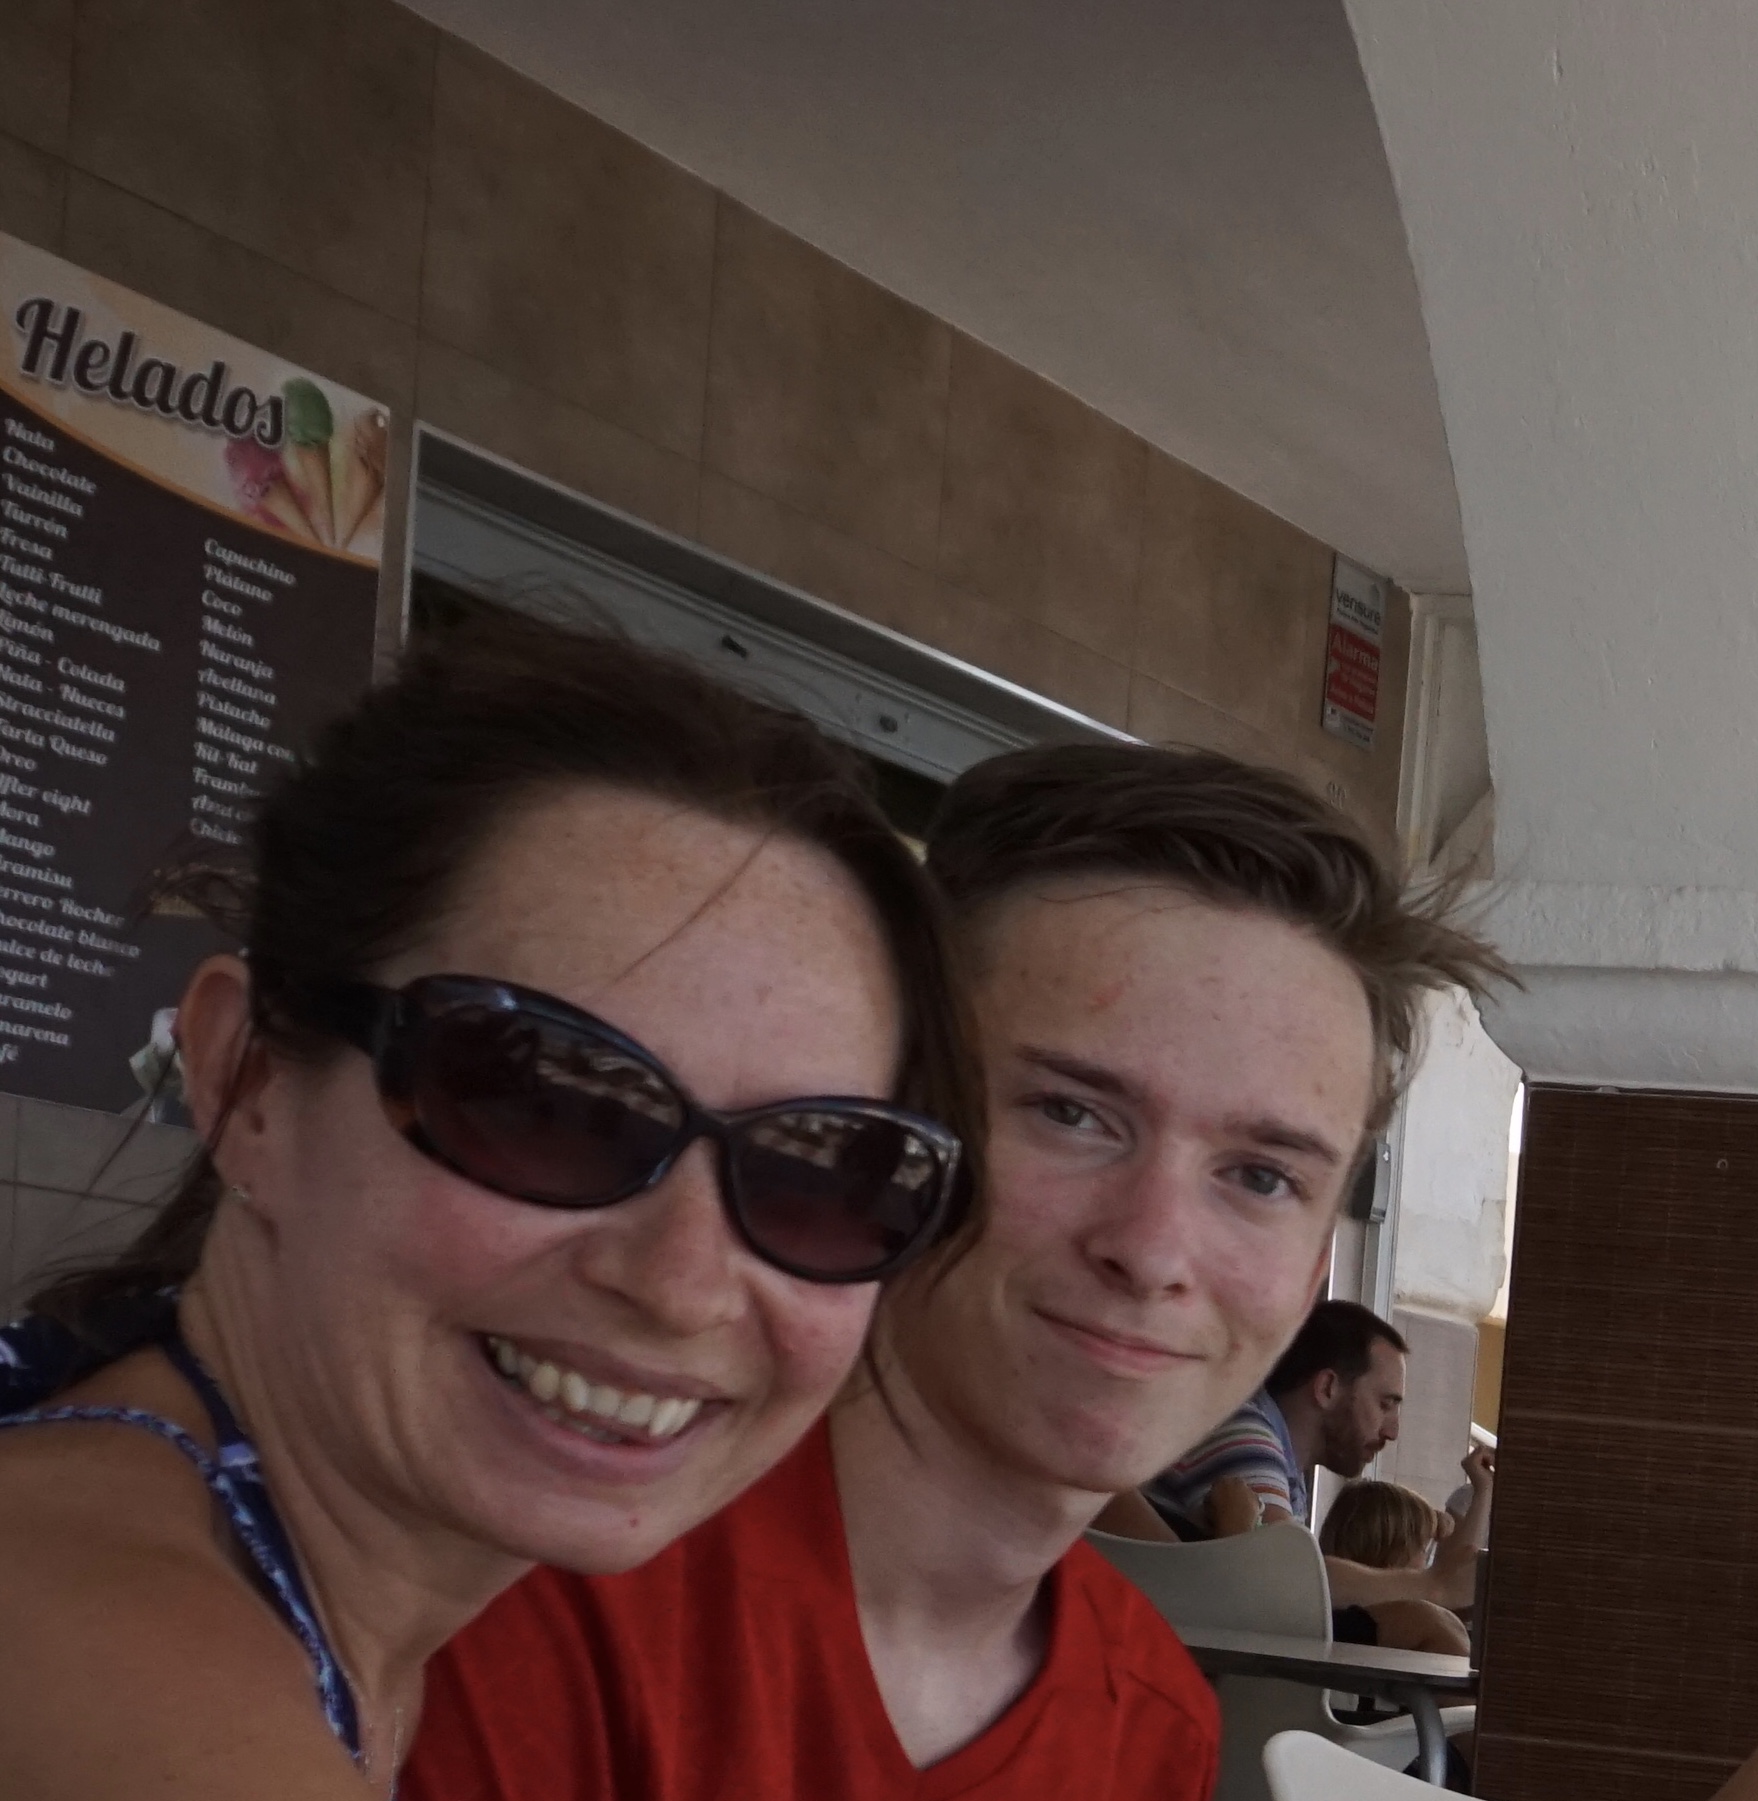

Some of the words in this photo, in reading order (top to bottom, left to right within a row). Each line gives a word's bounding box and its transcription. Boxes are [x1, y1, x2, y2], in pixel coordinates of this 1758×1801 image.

[15, 297, 285, 447] Helados
[2, 445, 98, 495] Chocolate
[1, 473, 84, 518] Vainilla
[204, 538, 296, 584] Capuchino
[202, 590, 242, 616] Coco
[52, 604, 161, 652] merengada
[200, 639, 275, 679] Naranja
[1331, 630, 1379, 671] Alarma
[57, 656, 125, 693] Colada
[49, 735, 108, 767] Queso
[42, 788, 92, 816] eight
